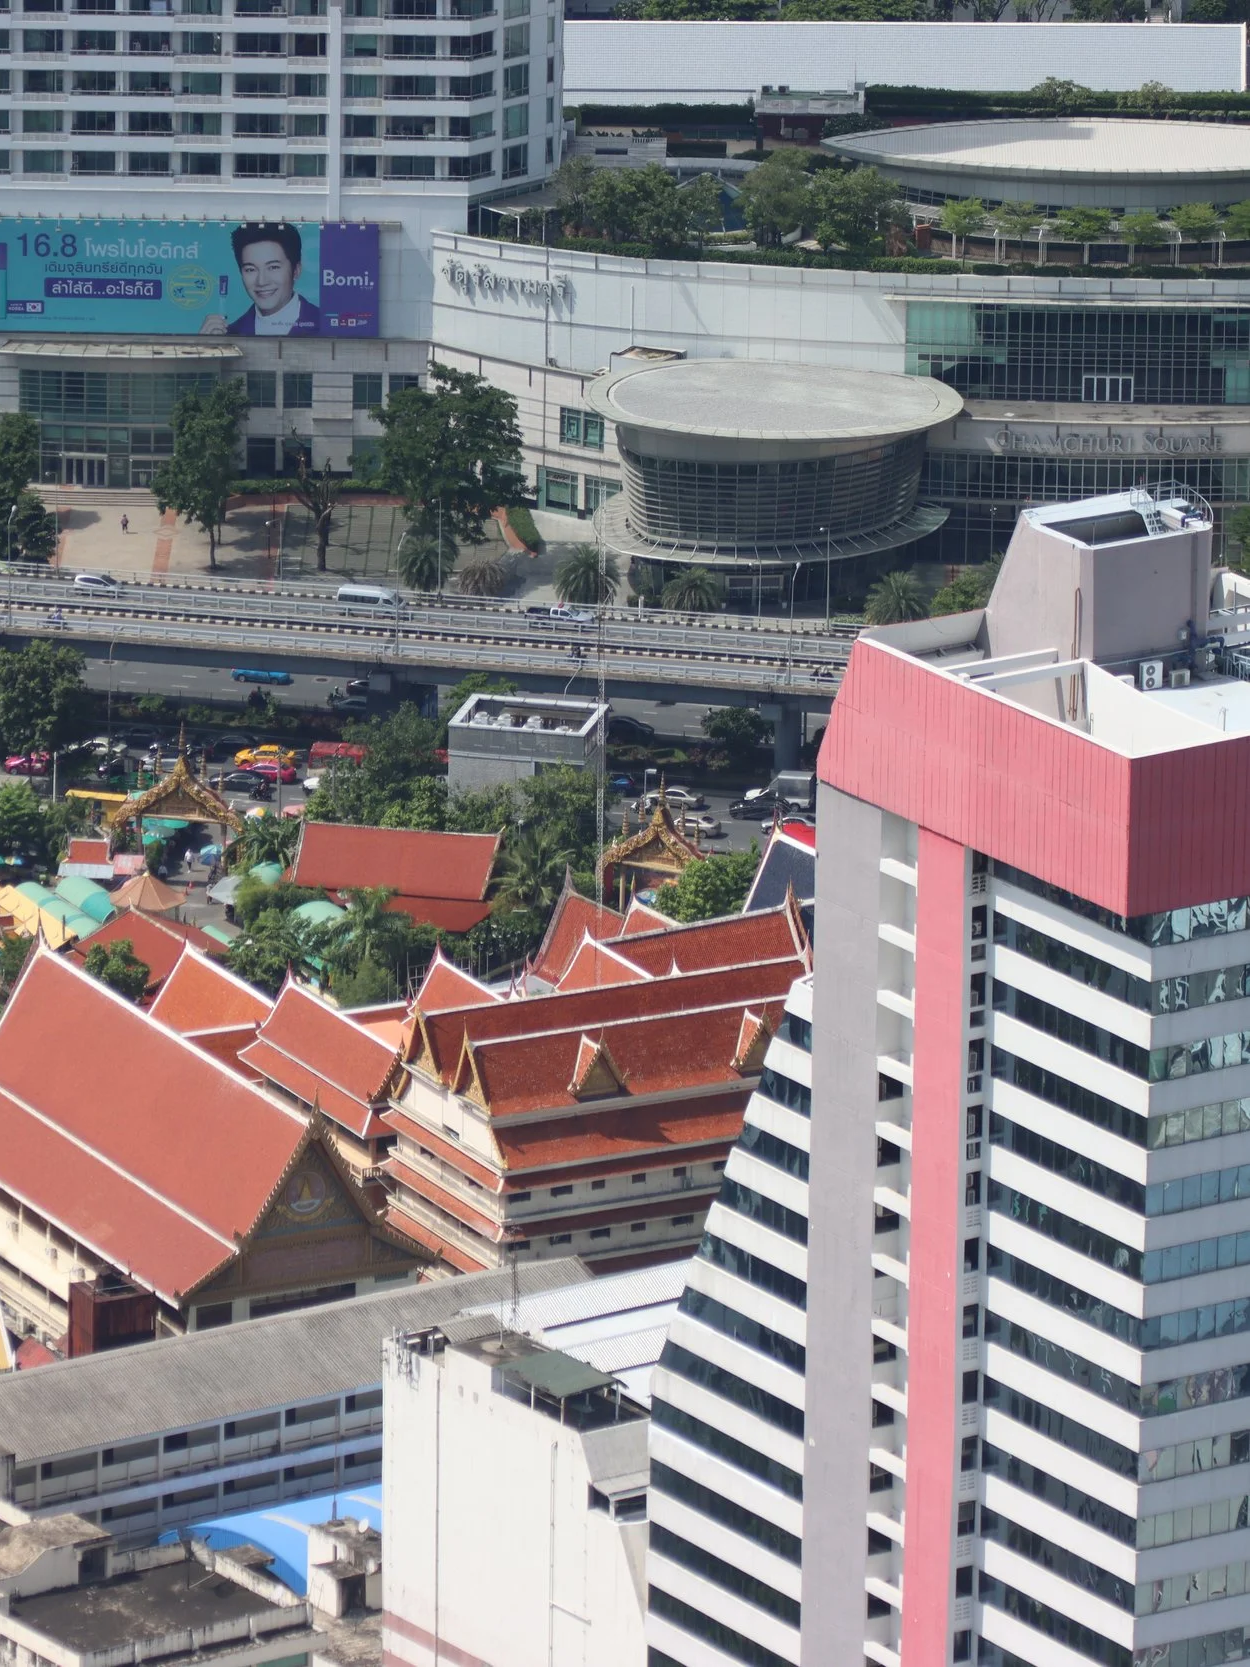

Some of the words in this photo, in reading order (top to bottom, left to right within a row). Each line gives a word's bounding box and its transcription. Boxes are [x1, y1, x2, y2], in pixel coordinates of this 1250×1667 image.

[16, 233, 78, 257] 16.8
[83, 237, 200, 259] โพรไบโอติกส์
[323, 269, 374, 286] Bomi.
[995, 430, 1133, 454] CHAMCHURI
[1142, 433, 1223, 456] SQUARE
